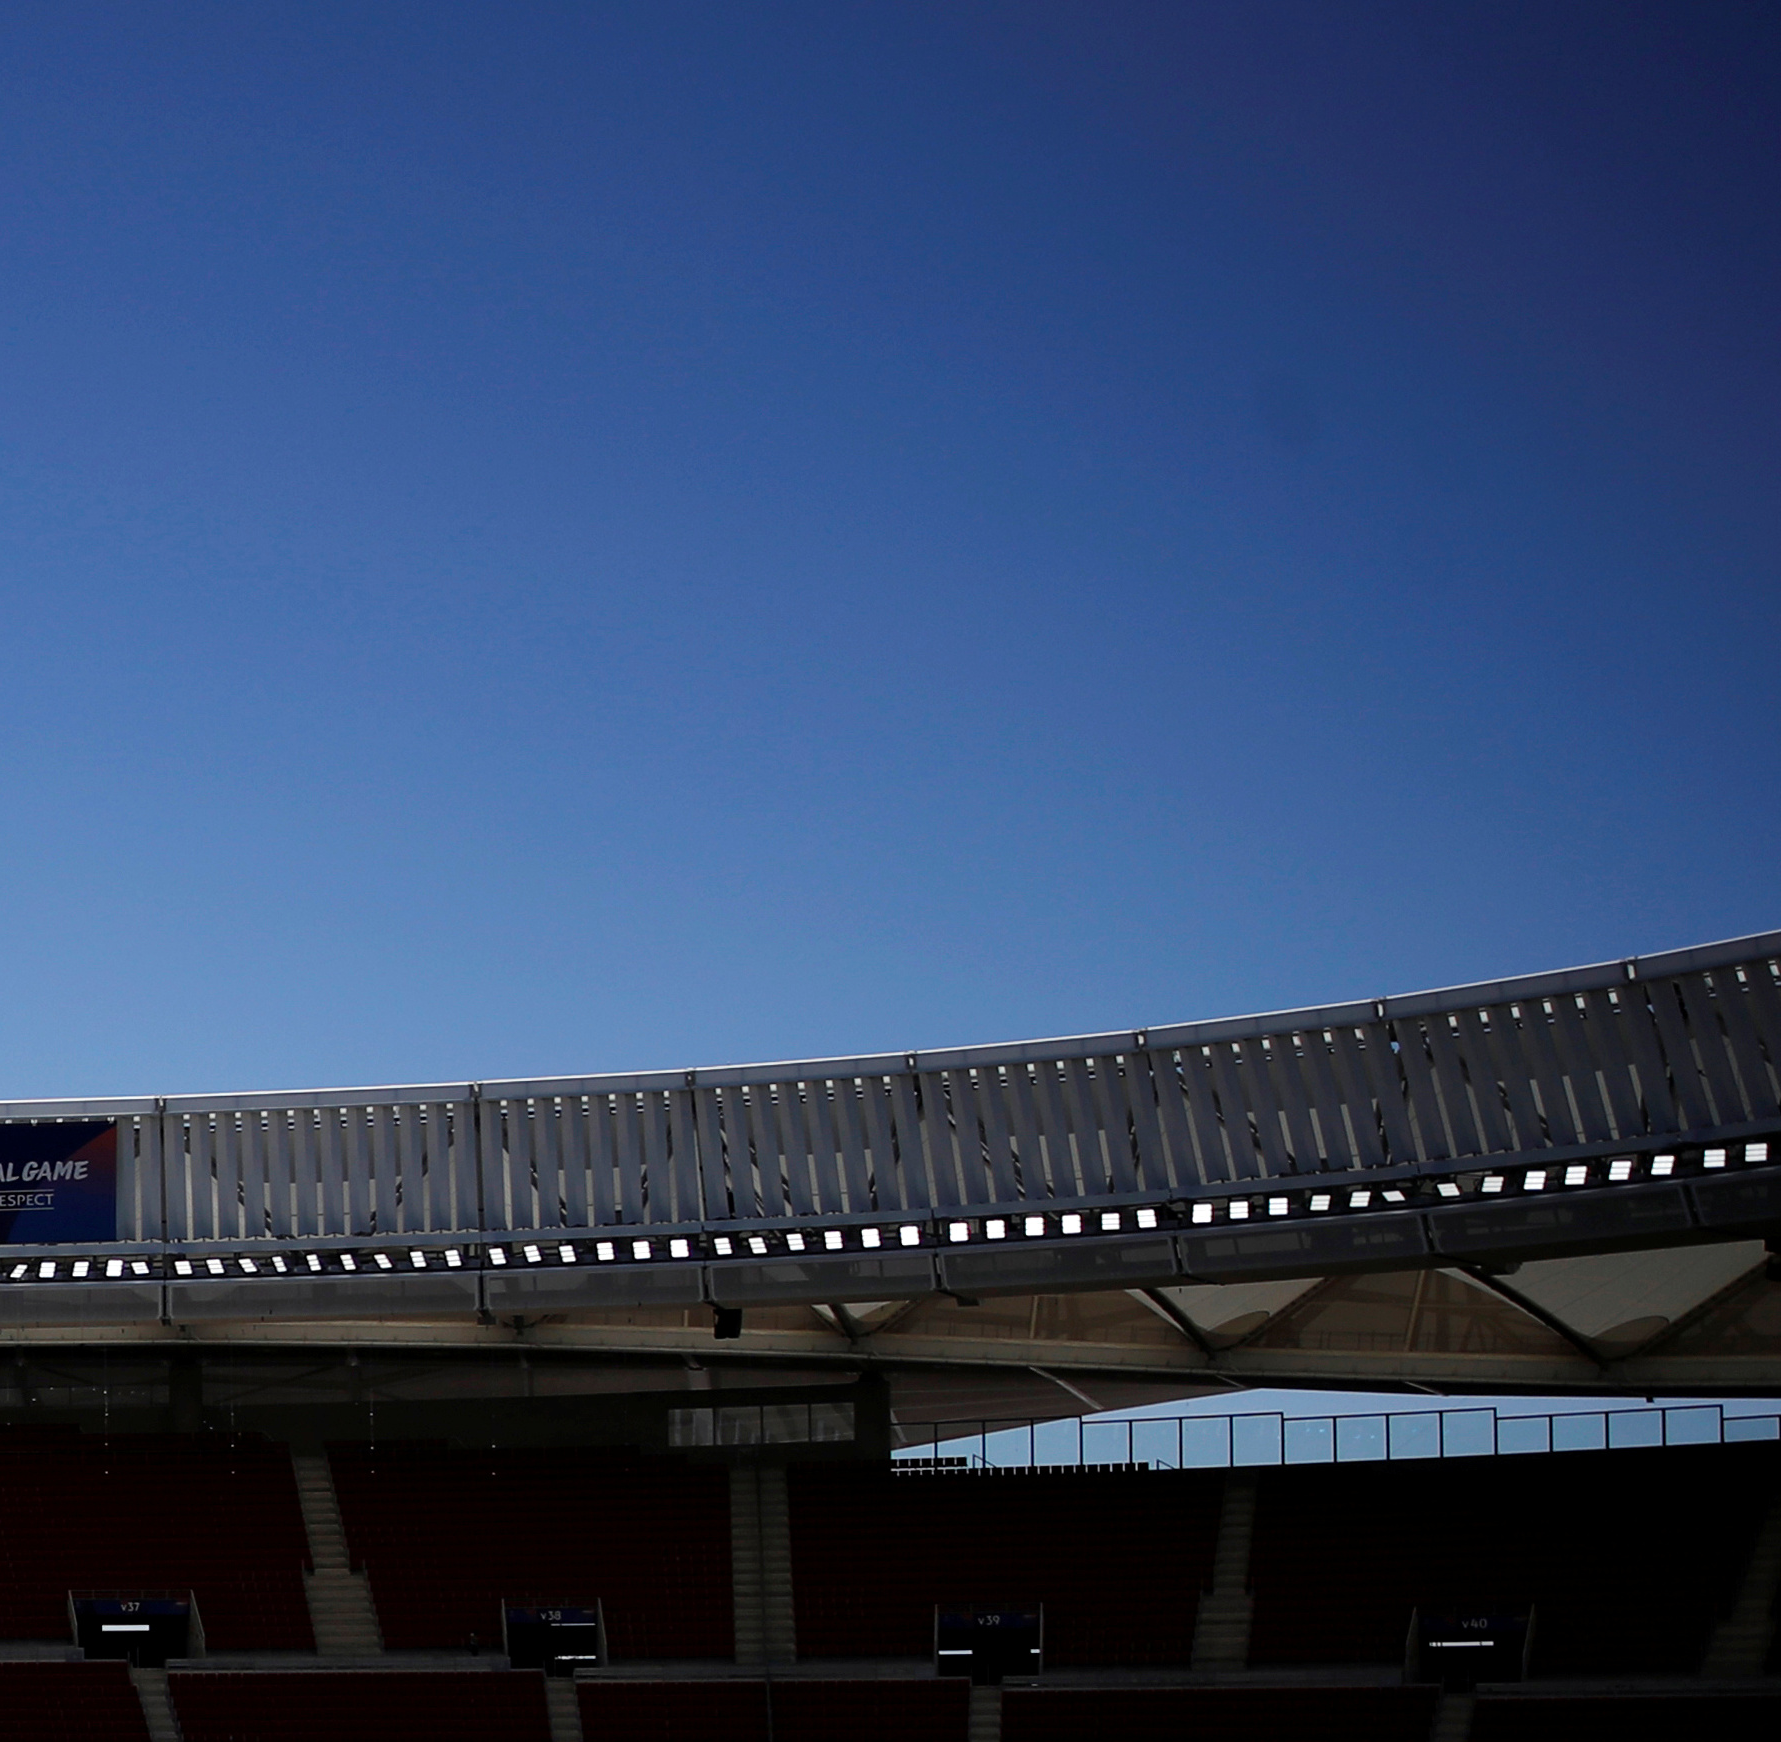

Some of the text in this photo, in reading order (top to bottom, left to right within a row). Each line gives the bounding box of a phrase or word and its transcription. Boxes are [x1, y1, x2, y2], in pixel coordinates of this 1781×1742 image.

[119, 1601, 141, 1613] v37
[539, 1610, 562, 1621] v38
[977, 1614, 1000, 1626] v39
[1460, 1617, 1489, 1630] v40
